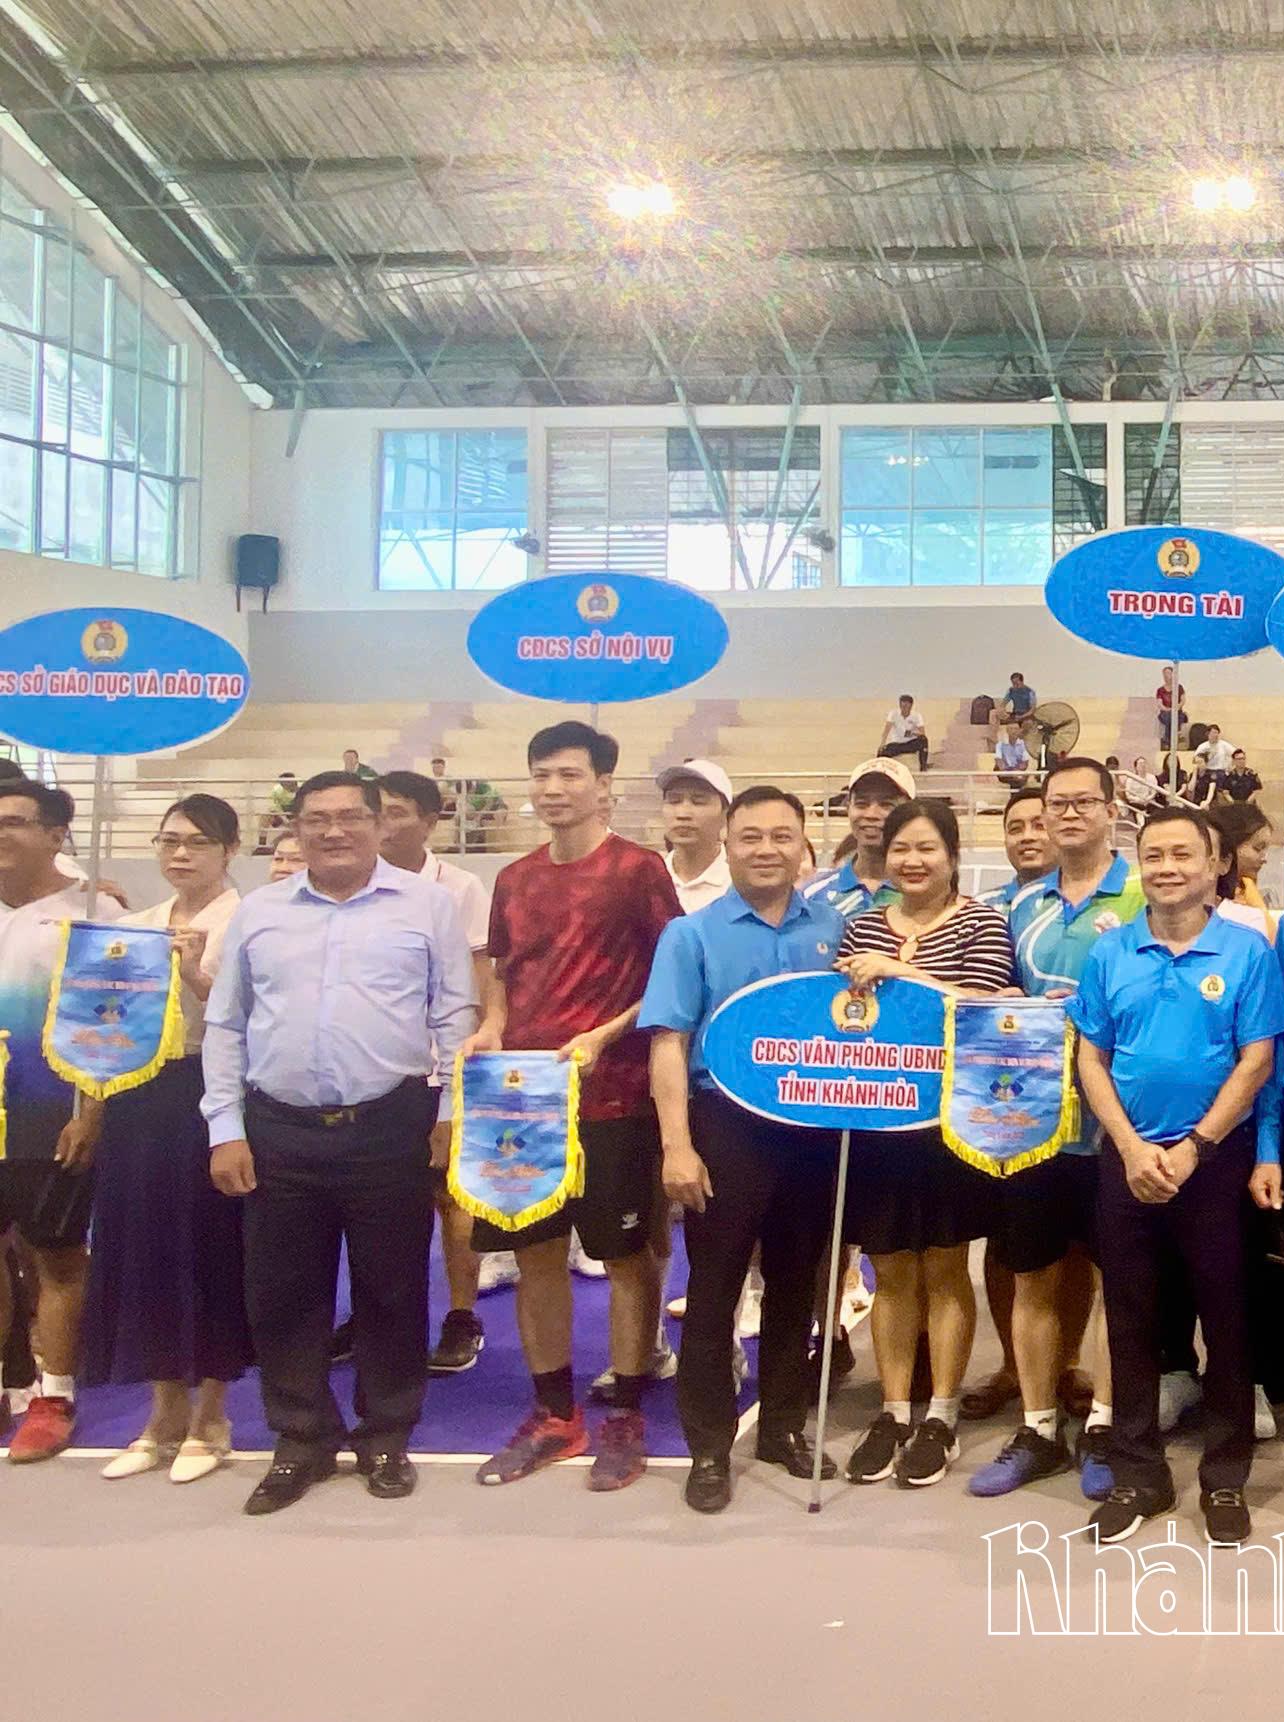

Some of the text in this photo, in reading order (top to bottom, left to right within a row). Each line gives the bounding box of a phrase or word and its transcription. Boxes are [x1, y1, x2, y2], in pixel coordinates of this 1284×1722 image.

[1109, 591, 1243, 618] TRỌNG TÀI
[576, 632, 603, 658] SỞ
[607, 633, 641, 662] NỘI
[647, 637, 672, 662] VỤ
[21, 666, 45, 694] SỞ
[50, 670, 89, 695] GIÁO
[94, 674, 130, 700] DỤC
[136, 671, 159, 695] VÀ
[164, 670, 201, 695] ĐÀO
[207, 676, 242, 701] TẠO
[803, 1037, 836, 1065] VĂN
[840, 1039, 899, 1067] PHÒNG
[903, 1048, 946, 1070] UBND
[779, 1072, 917, 1108] TỈNH KHÁNH HÒA
